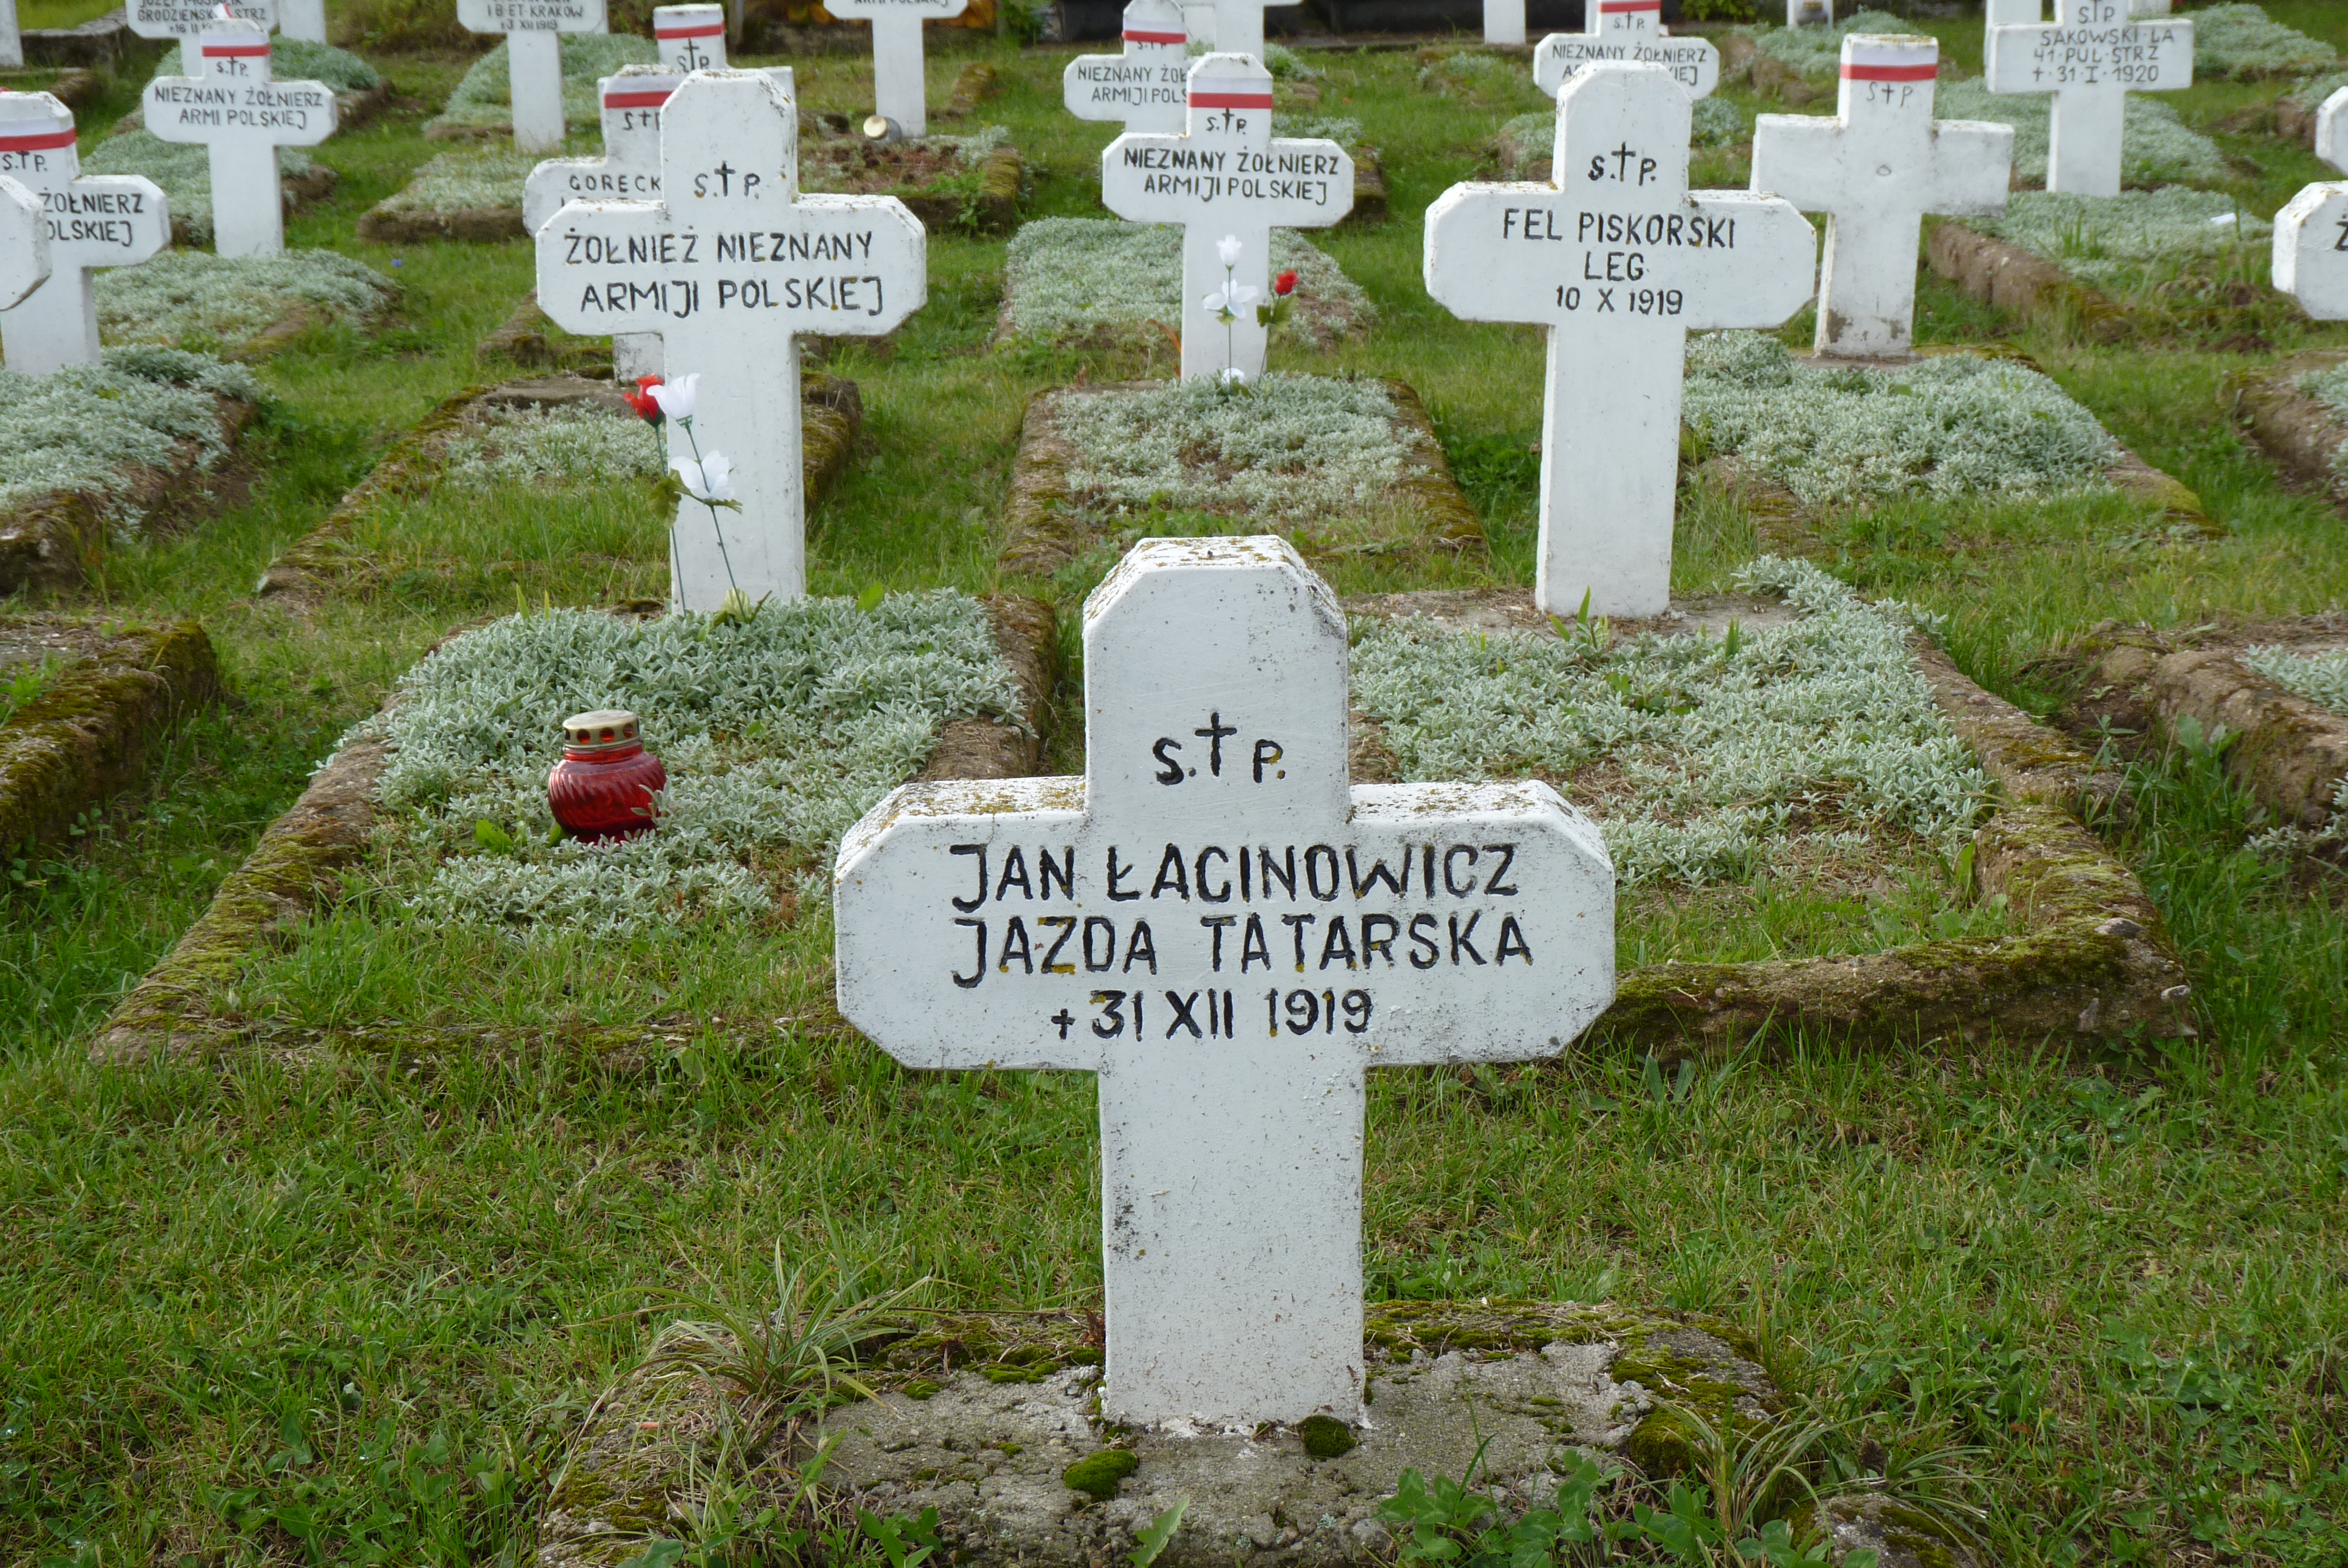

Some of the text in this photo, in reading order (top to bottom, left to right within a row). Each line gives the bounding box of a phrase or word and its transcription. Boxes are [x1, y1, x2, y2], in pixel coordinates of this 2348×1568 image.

[1552, 41, 1707, 62] NIEZNANY ŻOŁNIERZ
[1078, 65, 1152, 82] NIEZNANY
[2111, 65, 2160, 82] 1920
[154, 85, 323, 107] NIEZNANY ŻOŁNIERZ
[179, 108, 307, 130] ARMI POLSKIEJ
[1124, 145, 1340, 175] NIEZNANY ŻOŁNIERZ
[1144, 173, 1327, 205] ARMIJI POLSKIEJ
[47, 219, 133, 248] OLSKIEJ
[1503, 208, 1736, 249] FEL PISKORSKI
[717, 231, 872, 262] NIEZNANY
[580, 276, 883, 318] ARMIJI POLSKIEJ
[1556, 285, 1684, 316] 10 X 1919
[948, 841, 1520, 913] JAN ŁACINOWICZ
[951, 909, 1534, 989] JAZDA TATARSKA
[1165, 988, 1234, 1040] XII
[1264, 987, 1375, 1039] 1919
